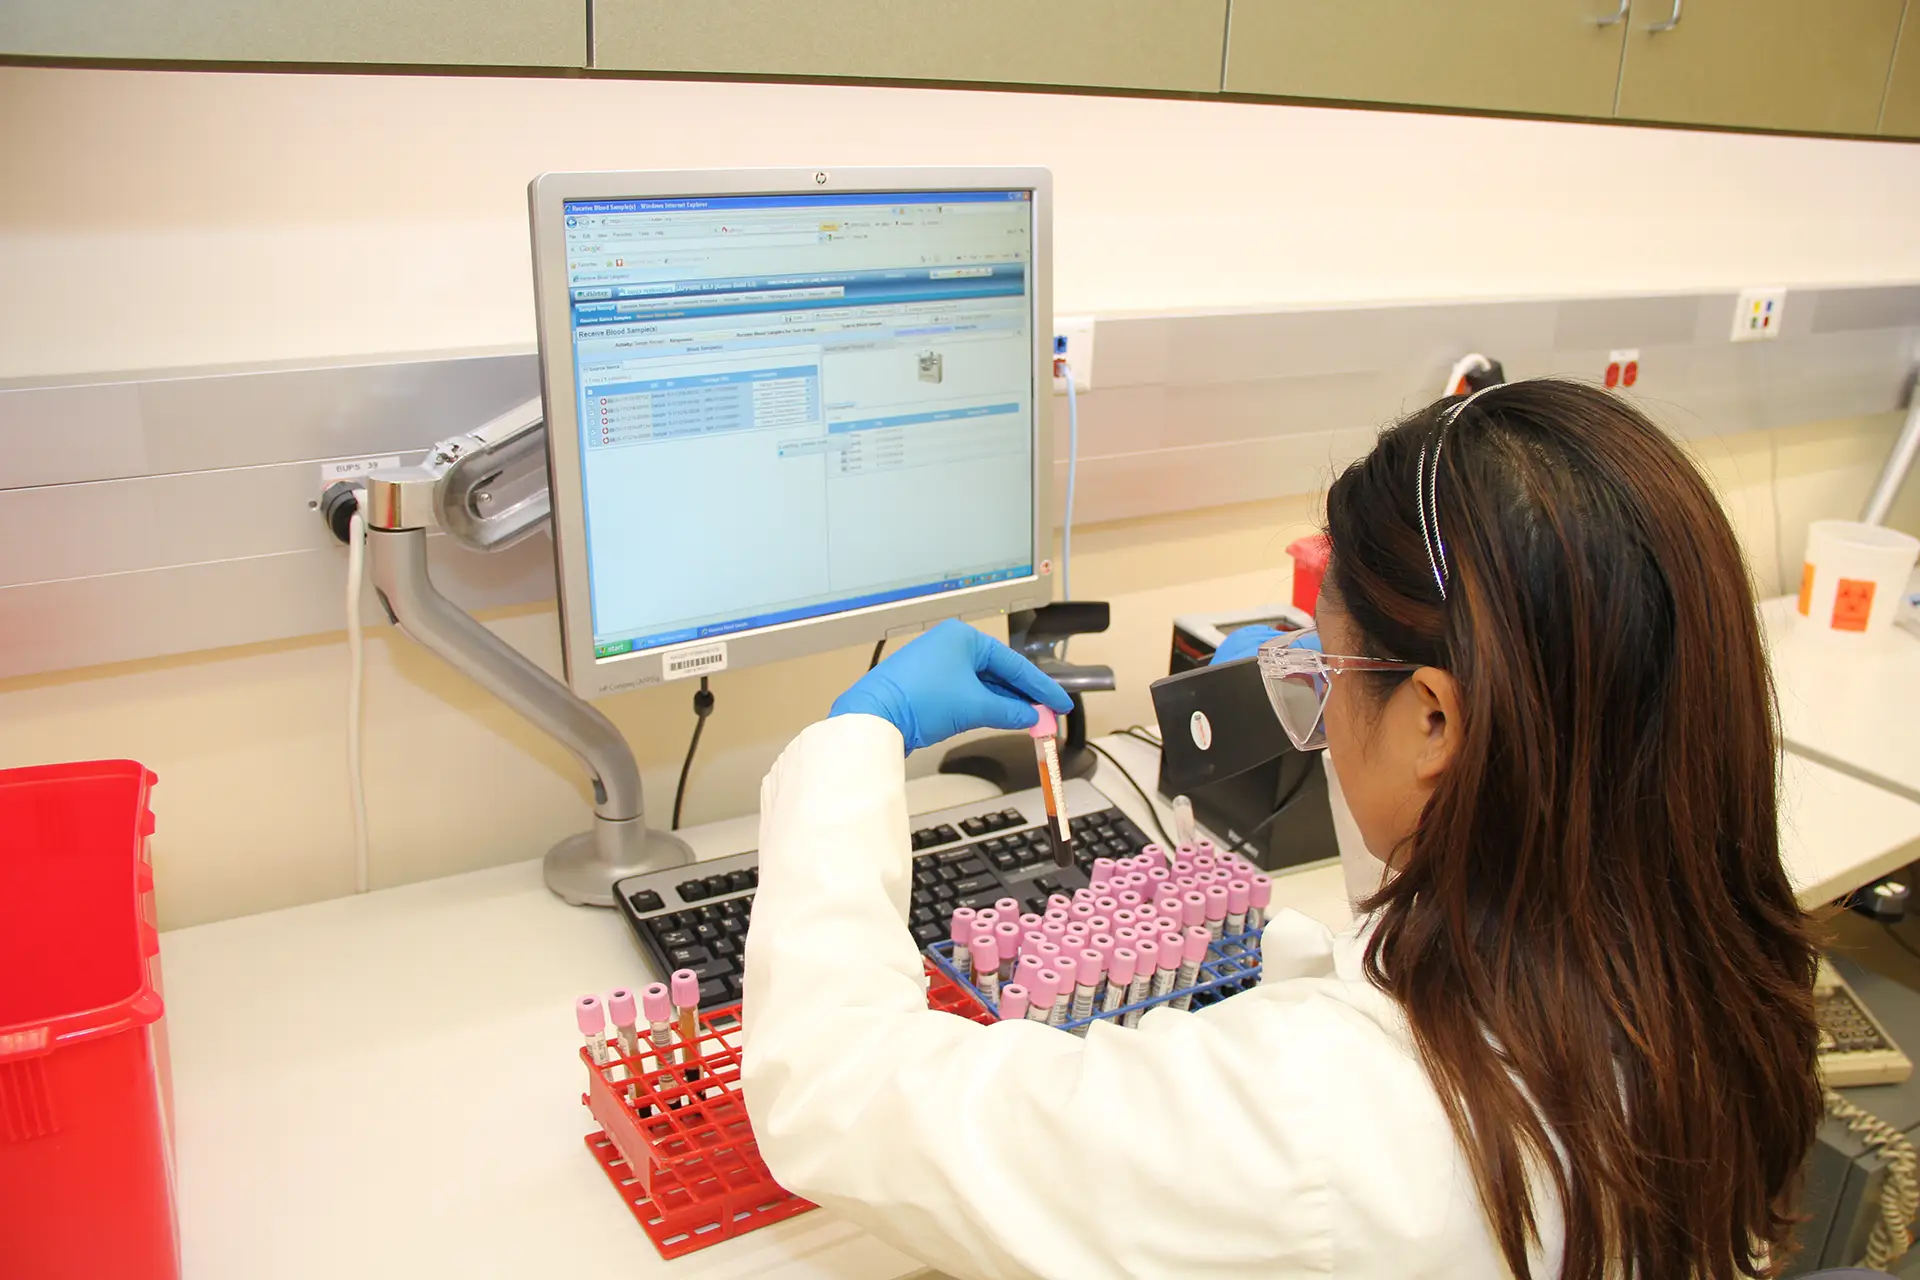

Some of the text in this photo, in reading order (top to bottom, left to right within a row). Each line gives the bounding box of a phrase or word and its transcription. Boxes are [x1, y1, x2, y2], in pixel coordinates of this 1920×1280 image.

[610, 203, 637, 211] Sample(s)
[687, 201, 708, 209] Explorer
[579, 245, 601, 253] Google
[579, 326, 658, 338] Receive Blood Sample(s)
[607, 643, 624, 652] start
